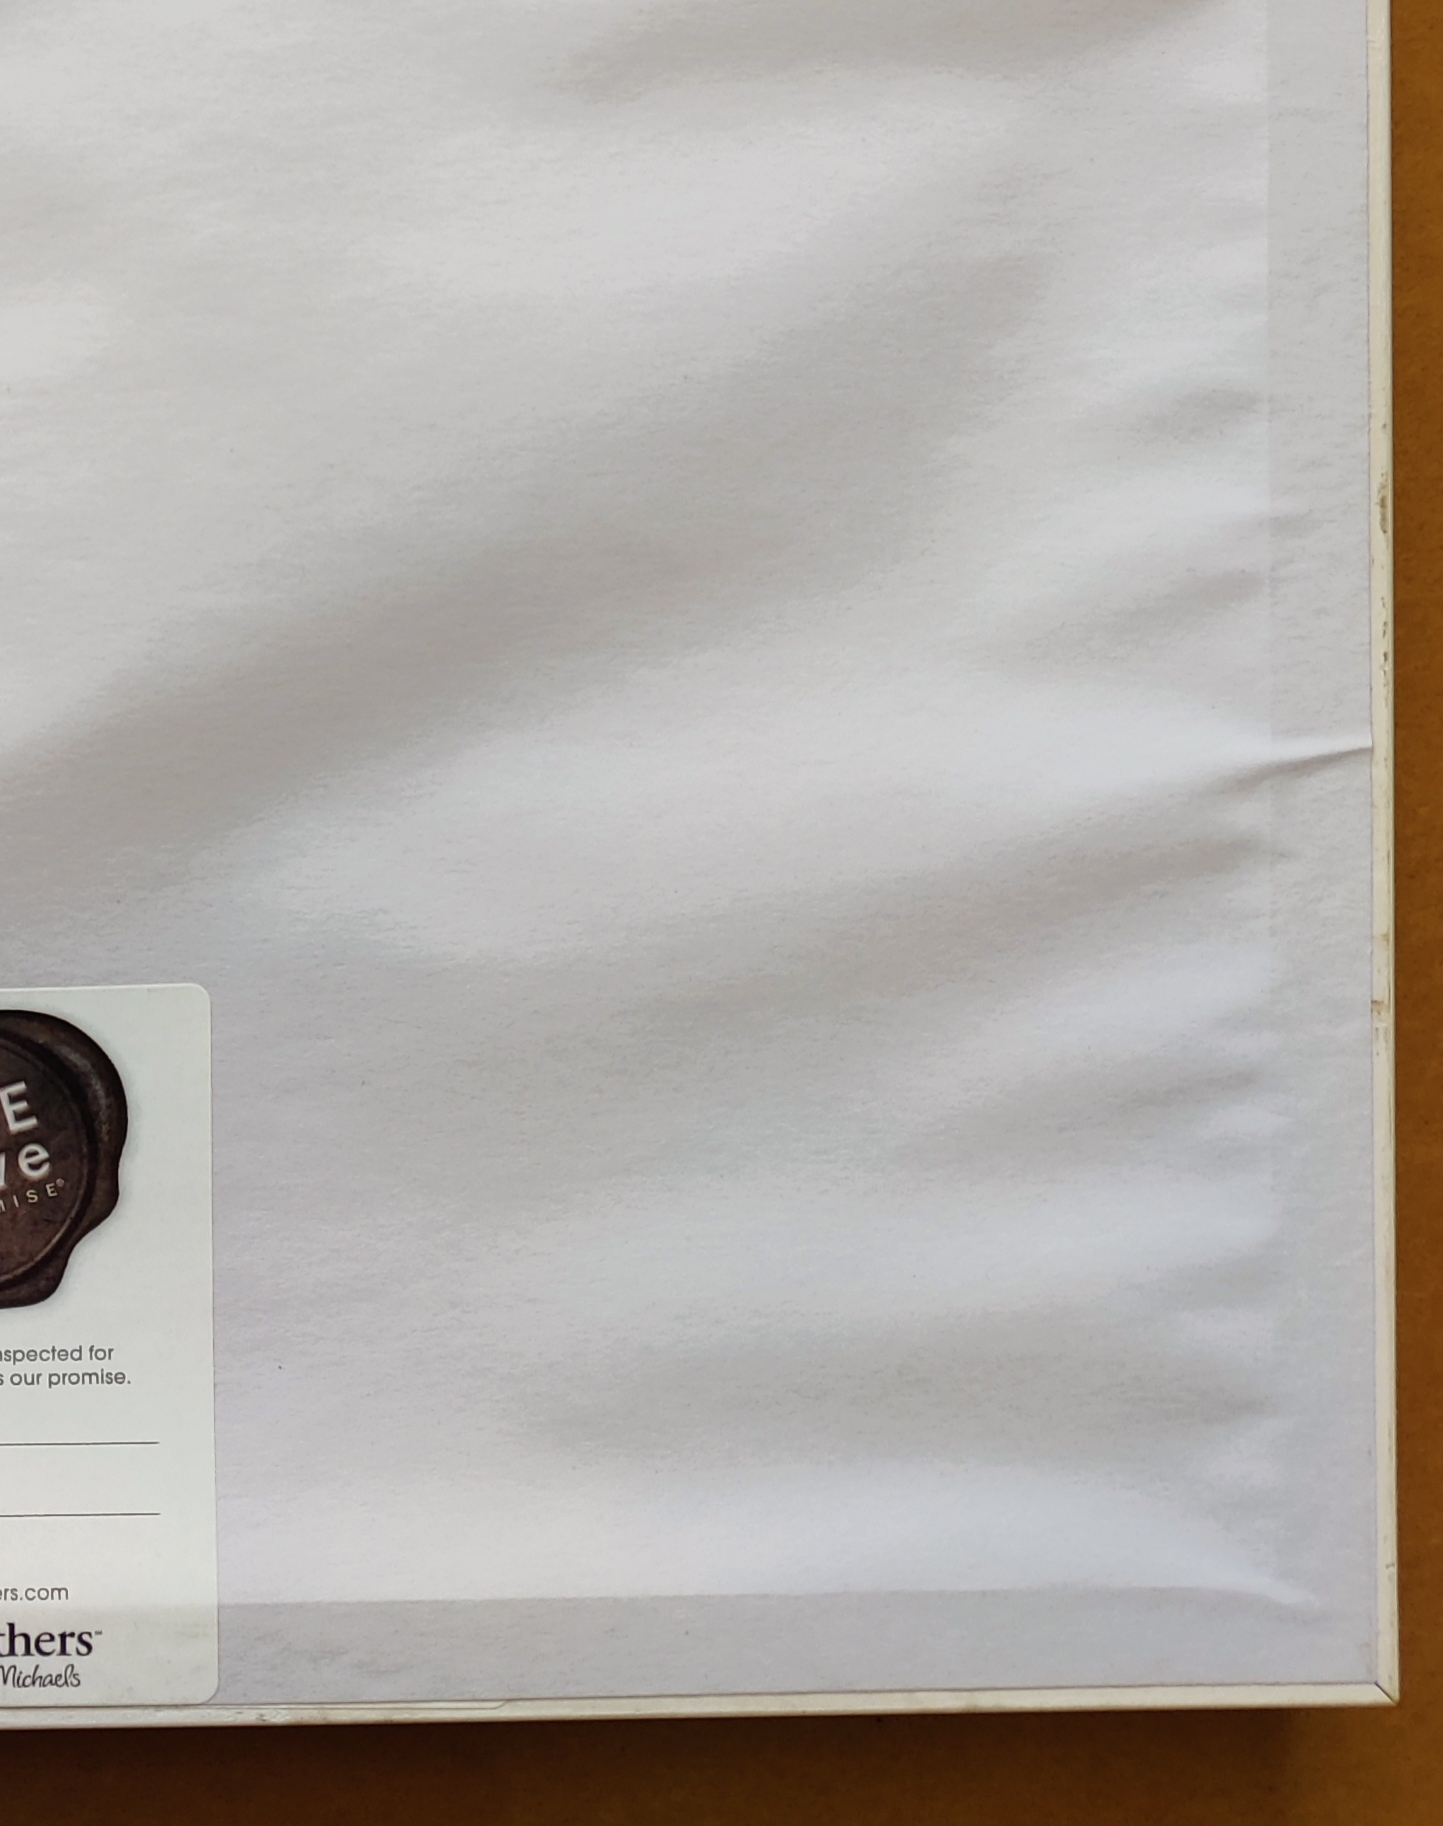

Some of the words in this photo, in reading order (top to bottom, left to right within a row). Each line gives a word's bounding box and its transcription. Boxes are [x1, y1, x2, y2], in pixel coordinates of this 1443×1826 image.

[88, 1344, 114, 1361] for
[9, 1372, 42, 1386] our
[48, 1367, 132, 1389] promise.
